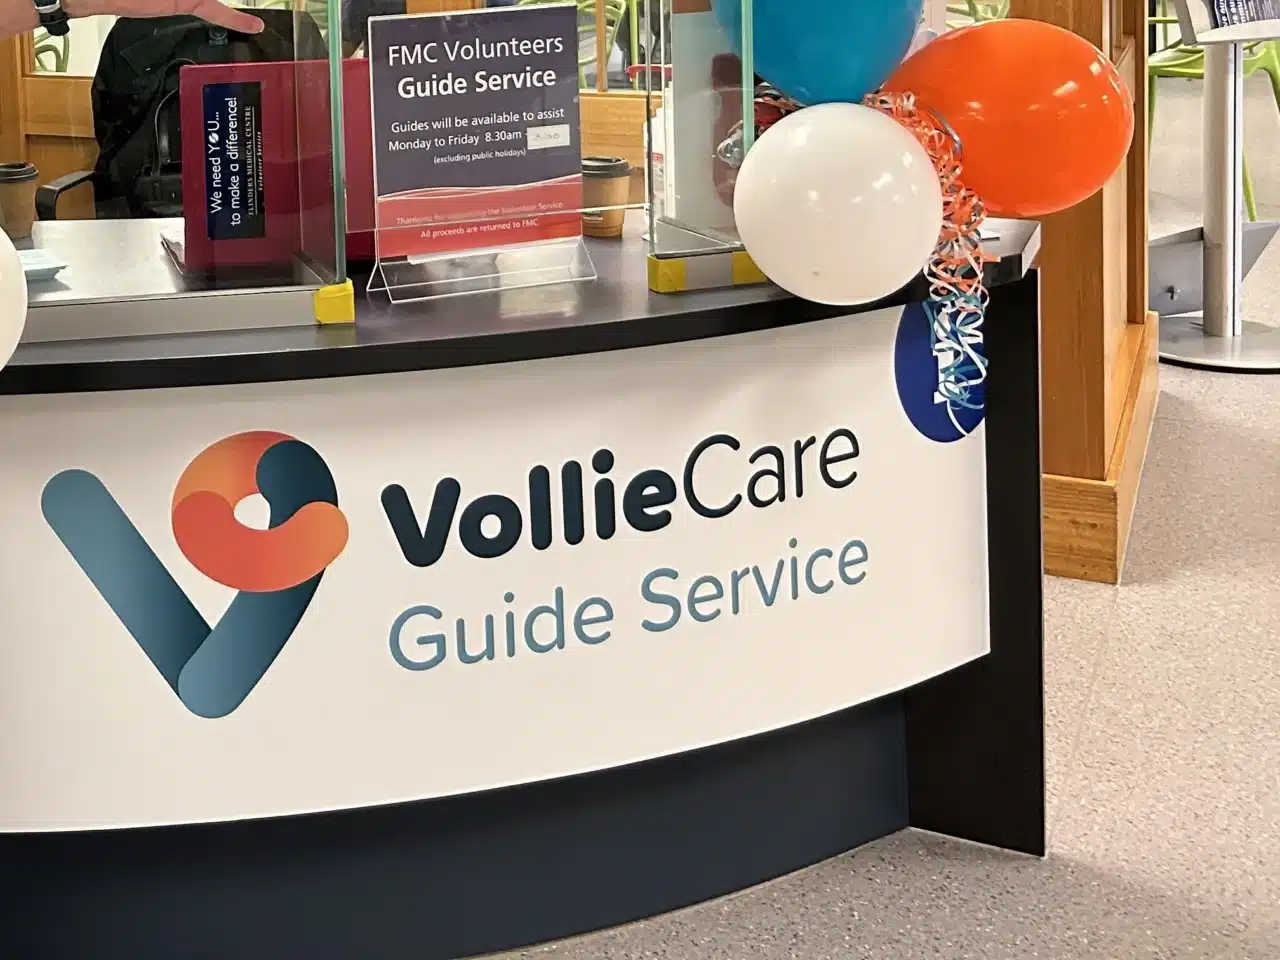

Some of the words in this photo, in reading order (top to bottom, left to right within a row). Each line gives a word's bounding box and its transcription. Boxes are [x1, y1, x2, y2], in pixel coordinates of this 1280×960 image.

[388, 42, 438, 67] FMC
[444, 36, 564, 61] Volunteers
[397, 73, 468, 99] Guide
[475, 66, 557, 93] Service
[224, 97, 239, 159] difference!
[244, 106, 252, 137] CENTRE
[391, 120, 429, 134] Guides
[432, 117, 452, 130] will
[455, 115, 469, 127] be
[471, 111, 520, 126] available
[523, 112, 534, 121] to
[537, 108, 565, 120] assist
[388, 138, 431, 152] Monday
[434, 137, 445, 147] to
[448, 133, 480, 147] Friday
[485, 131, 522, 142] 8.30am
[433, 153, 471, 165] (excluding
[472, 150, 493, 162] public
[495, 148, 527, 159] holidays)
[208, 158, 221, 187] need
[230, 163, 239, 171] a
[245, 140, 253, 176] MEDICAL
[210, 191, 223, 214] We
[227, 175, 241, 209] make
[246, 177, 255, 216] FLINDERS
[538, 200, 564, 210] Service
[230, 212, 241, 226] to
[421, 230, 431, 239] All
[432, 226, 465, 239] proceeds
[466, 225, 478, 234] are
[479, 222, 511, 233] returned
[513, 220, 521, 228] to
[521, 218, 539, 227] FMC
[380, 427, 860, 568] VollieCare
[389, 586, 614, 671] Guide
[640, 537, 869, 632] Service
